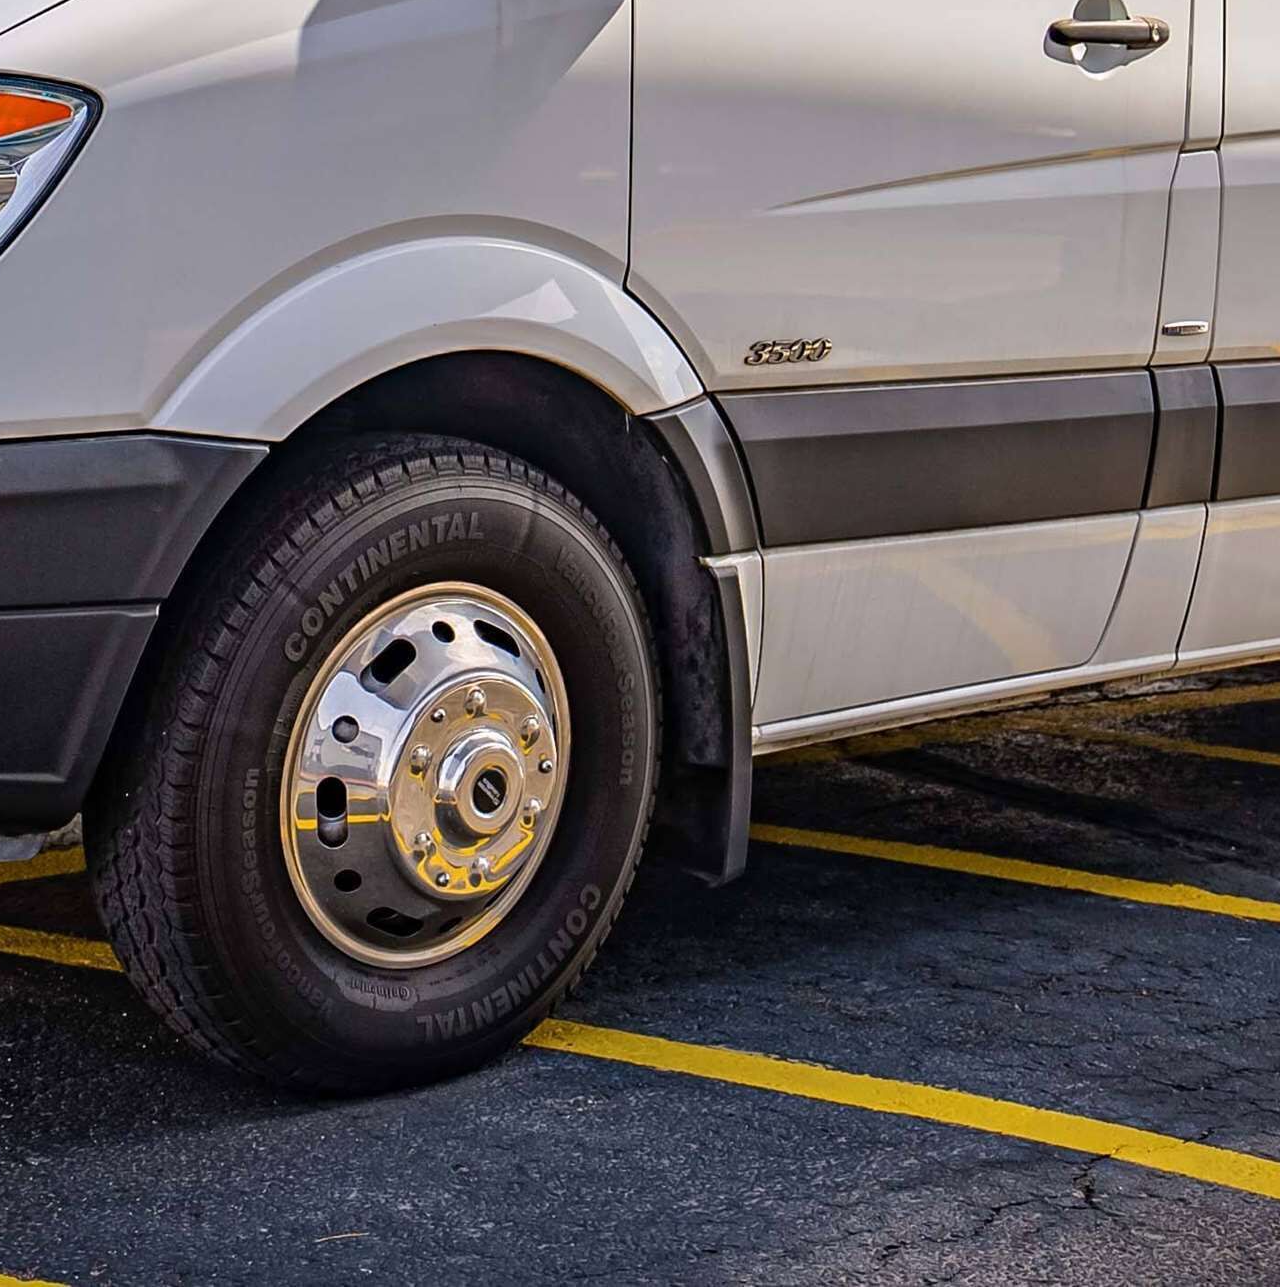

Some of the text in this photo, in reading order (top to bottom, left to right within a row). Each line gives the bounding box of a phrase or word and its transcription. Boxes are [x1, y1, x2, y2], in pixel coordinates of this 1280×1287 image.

[744, 337, 833, 366] 3500
[284, 511, 487, 662] CONTINENTAL
[417, 882, 603, 1041] CONTINENTAL
